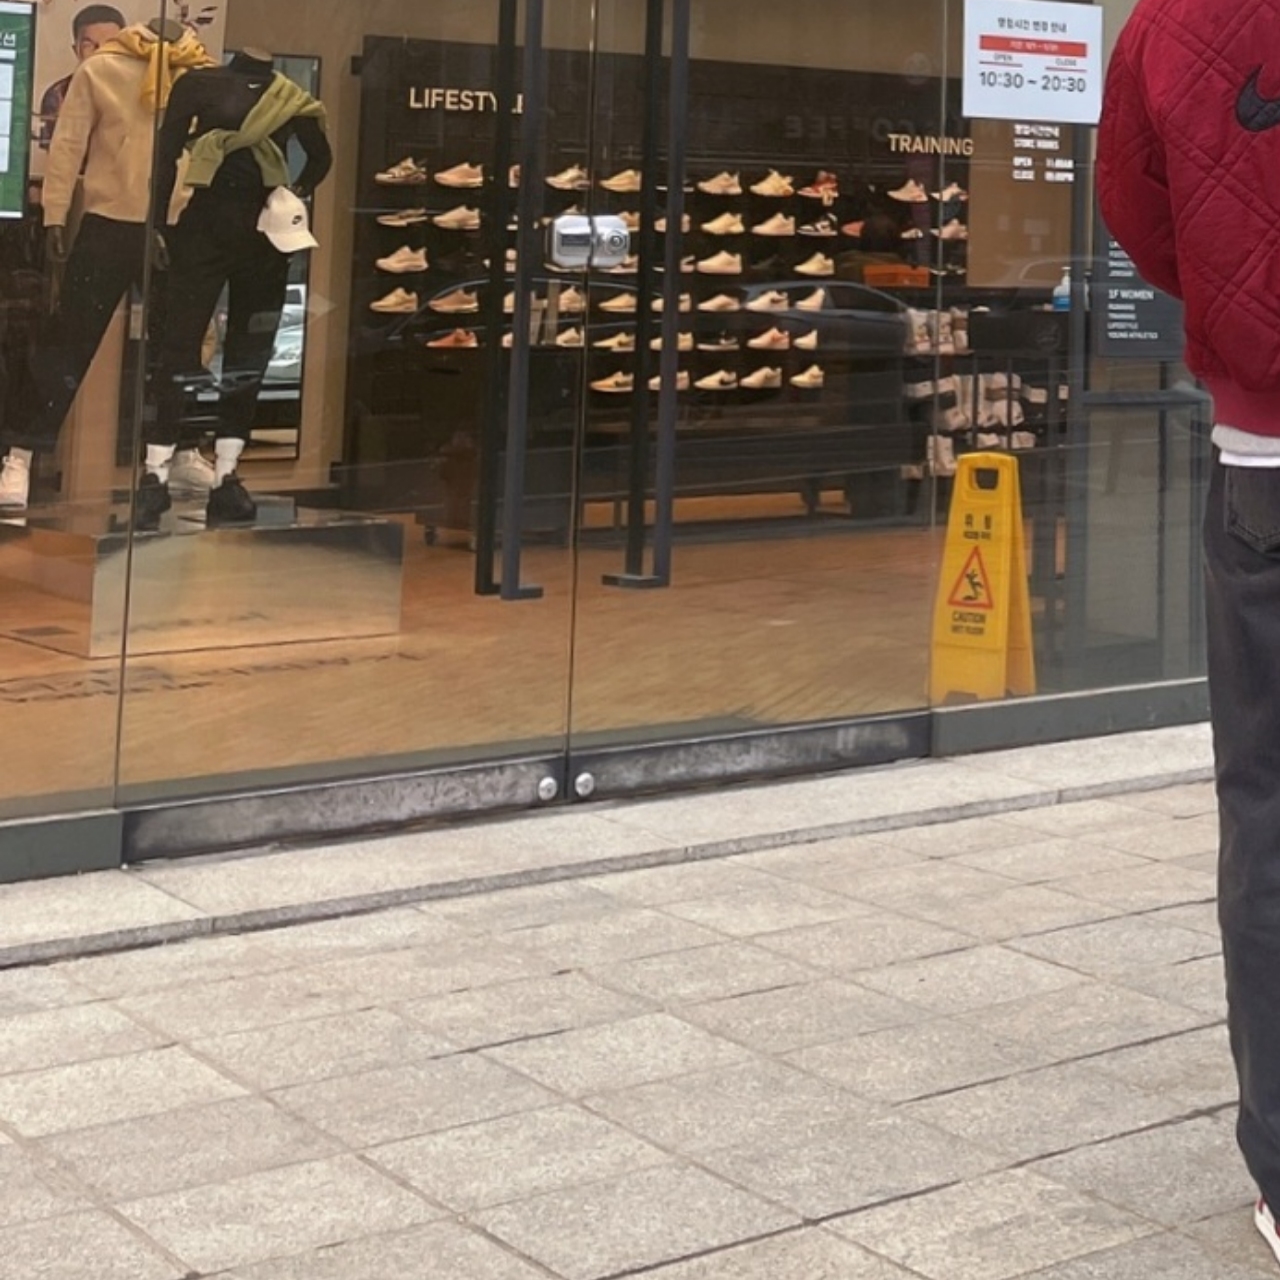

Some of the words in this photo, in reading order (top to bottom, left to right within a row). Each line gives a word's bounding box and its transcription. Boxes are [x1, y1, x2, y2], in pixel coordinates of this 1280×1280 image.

[979, 70, 1024, 89] 10:30
[1041, 74, 1087, 93] 20:30
[886, 133, 975, 156] TRAINING
[1120, 289, 1154, 300] WOMEN
[953, 611, 986, 624] CAUTION
